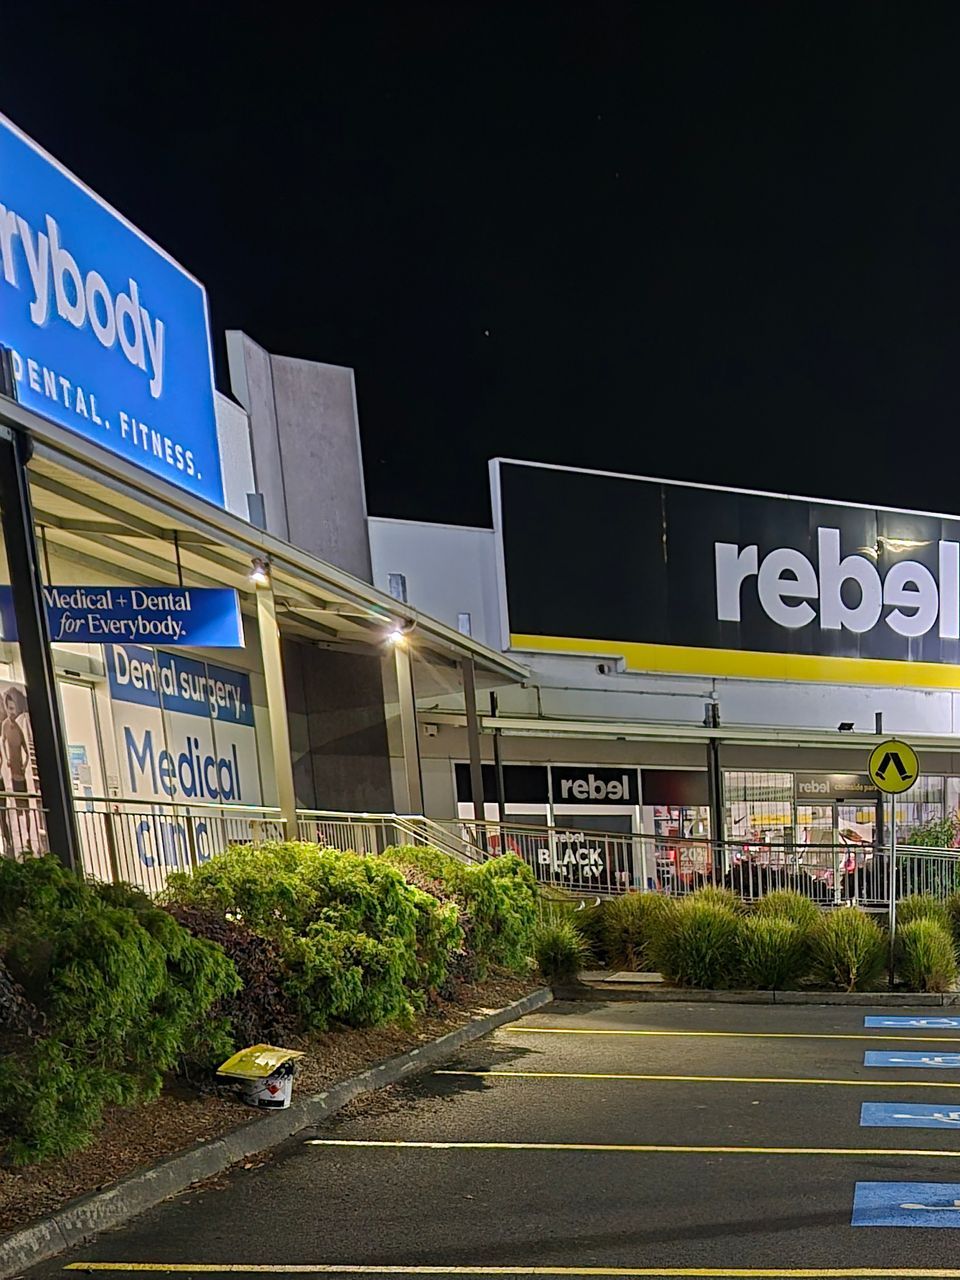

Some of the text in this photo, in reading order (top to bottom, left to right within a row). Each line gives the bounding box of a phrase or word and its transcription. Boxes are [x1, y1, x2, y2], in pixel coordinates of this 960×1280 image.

[12, 349, 202, 480] DENTAL. FITNESS.
[715, 527, 960, 639] rebel
[44, 588, 113, 610] Medical
[130, 590, 192, 611] Dental
[55, 611, 187, 641] for Everybody.
[113, 644, 247, 719] Dental surgery.
[123, 726, 242, 801] Medical
[561, 774, 630, 800] rebel
[799, 780, 830, 793] rebel
[538, 848, 603, 865] BLACK
